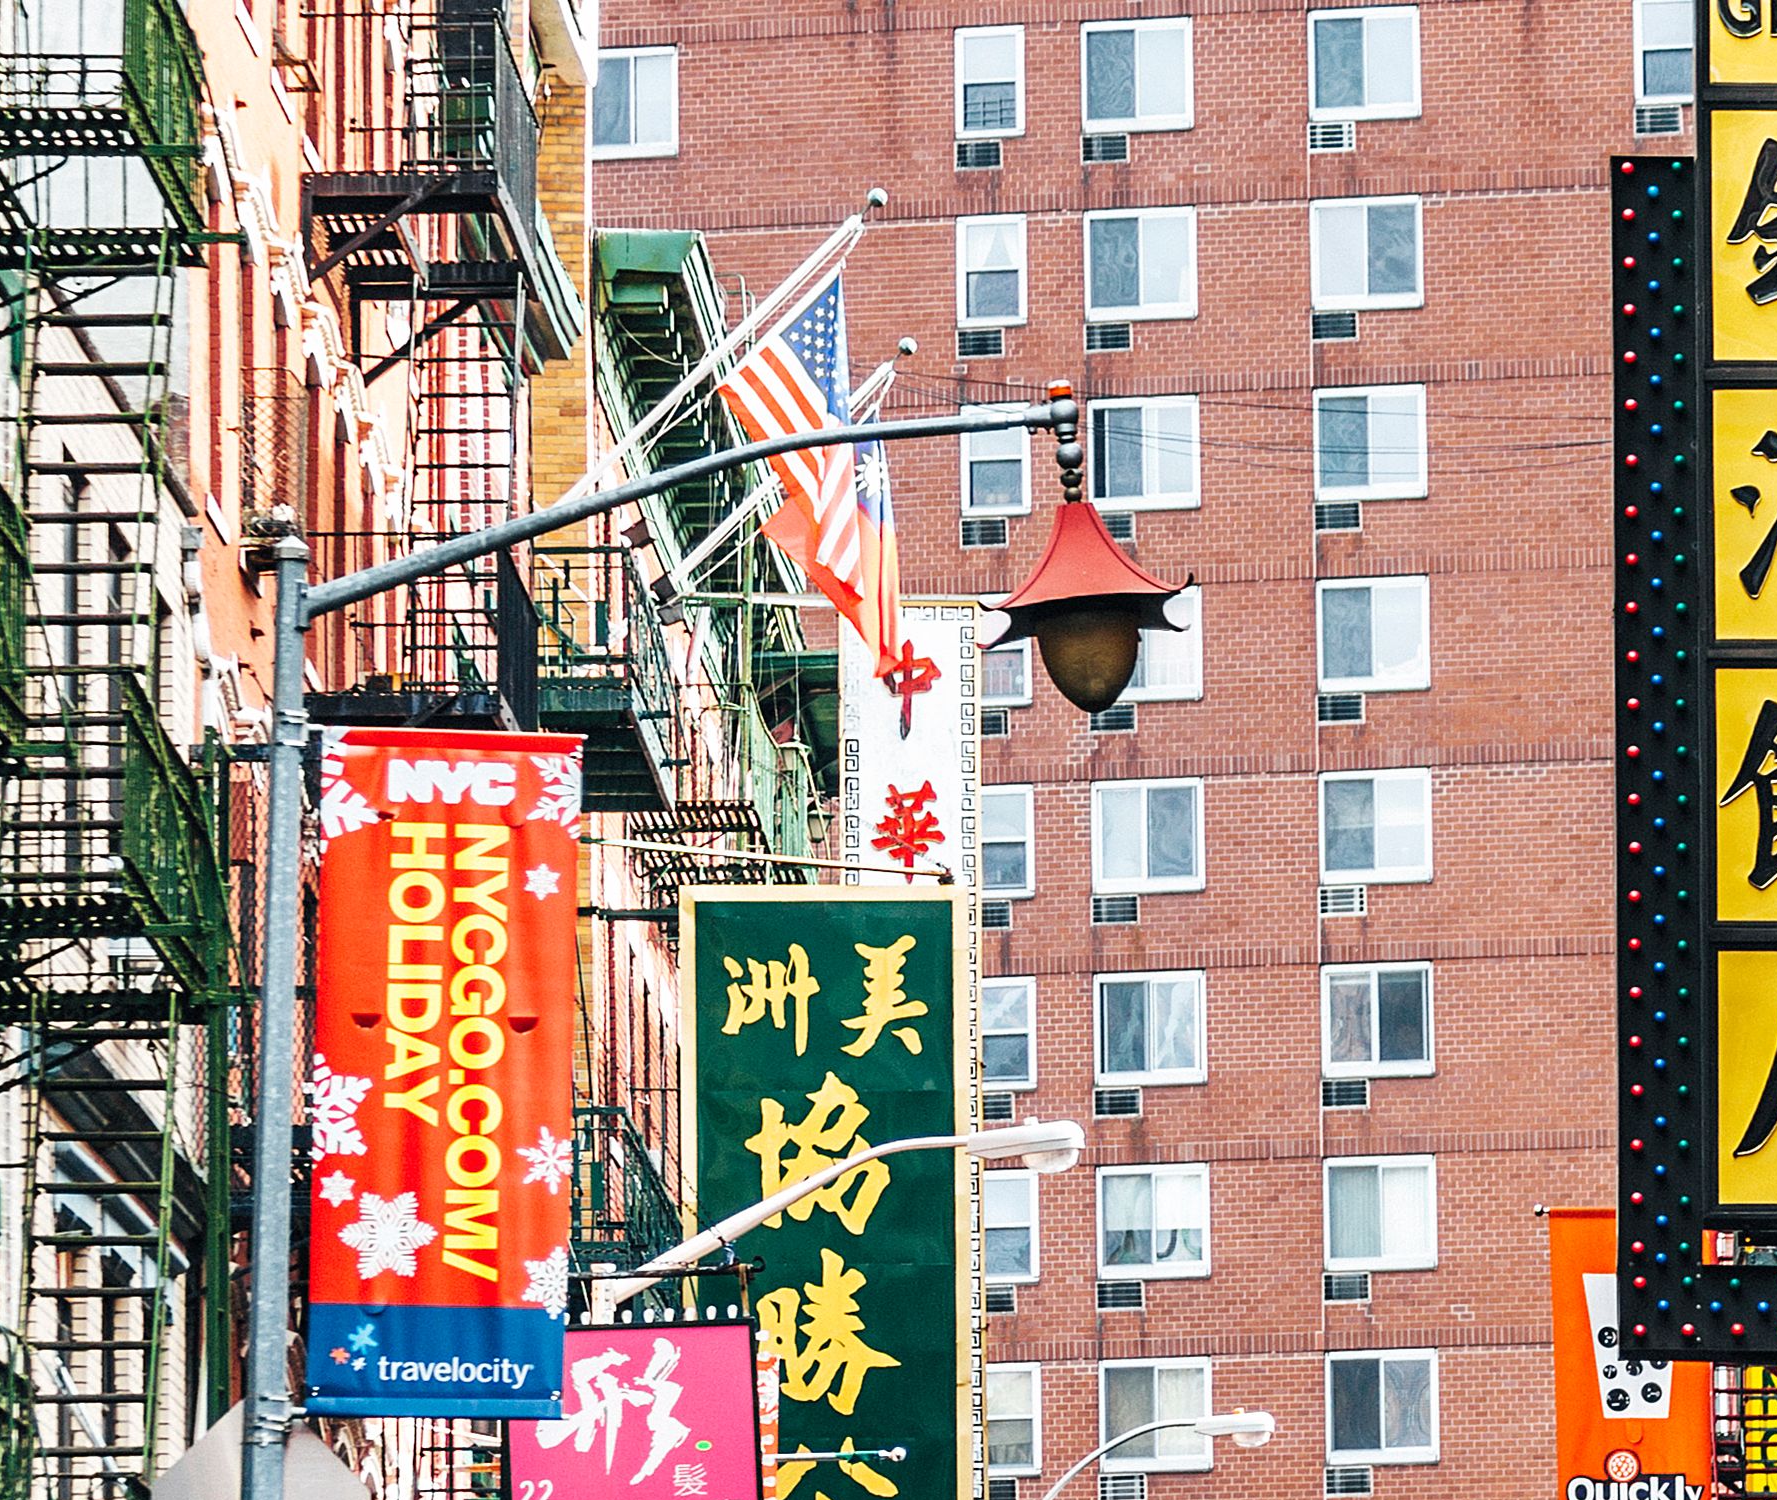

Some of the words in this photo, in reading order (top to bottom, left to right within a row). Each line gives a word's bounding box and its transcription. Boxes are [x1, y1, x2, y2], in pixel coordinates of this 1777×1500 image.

[388, 760, 516, 805] NYC
[384, 820, 446, 1127] HOLIDAY
[442, 823, 511, 1283] NYCGO.COM/
[378, 1355, 531, 1387] travelocity
